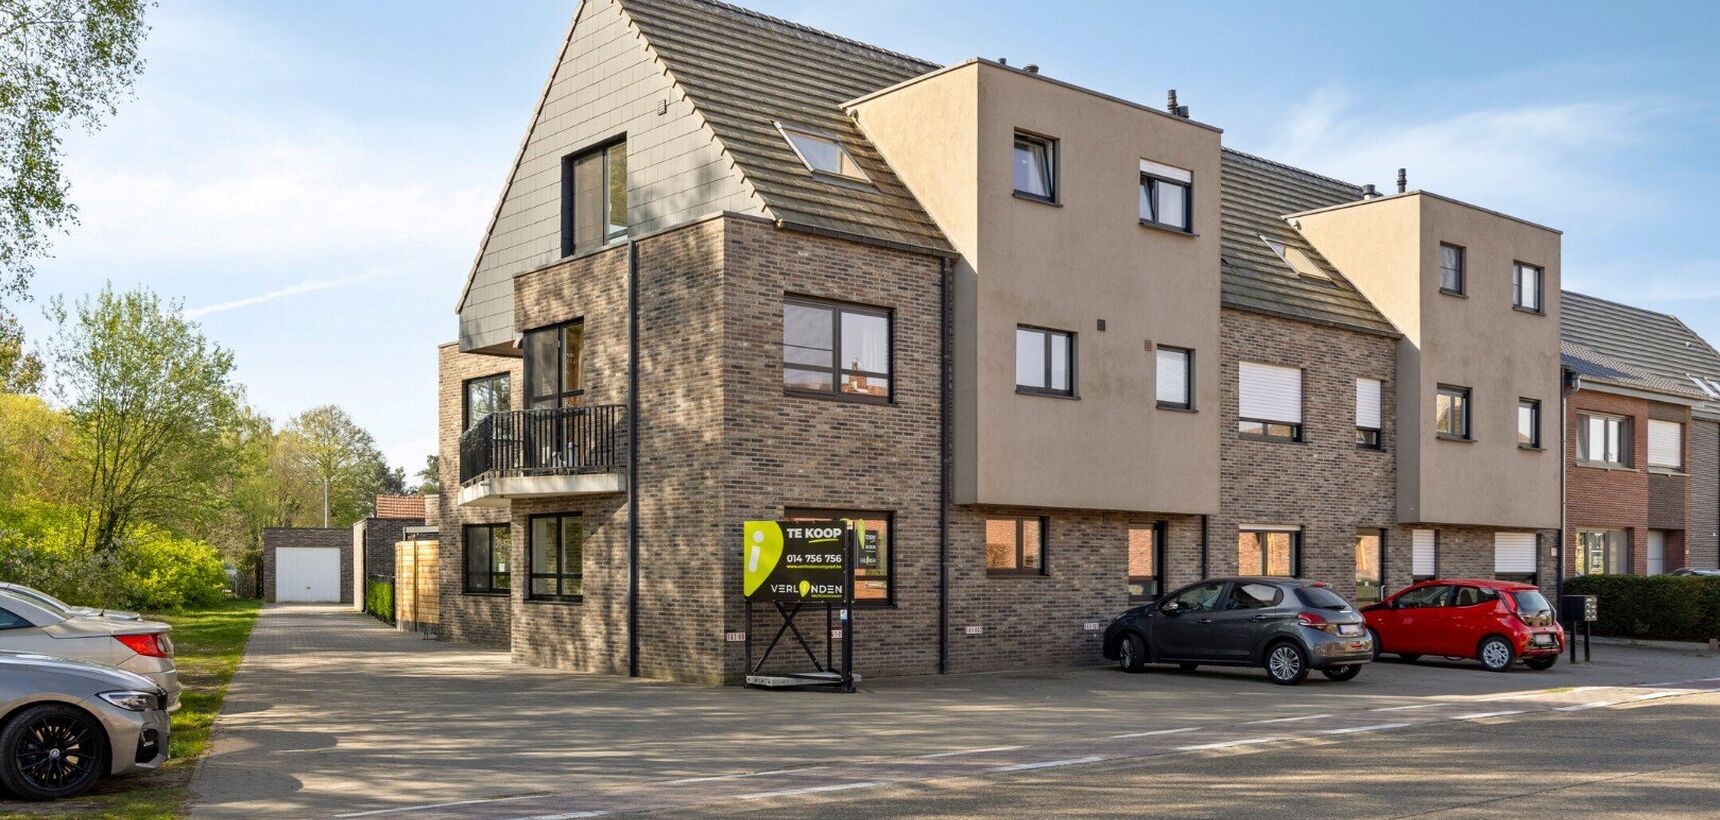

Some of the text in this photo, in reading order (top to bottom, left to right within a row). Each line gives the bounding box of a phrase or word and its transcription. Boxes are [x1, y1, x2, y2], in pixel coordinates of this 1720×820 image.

[786, 527, 842, 538] TE KOOP
[786, 554, 842, 563] 014 756 756
